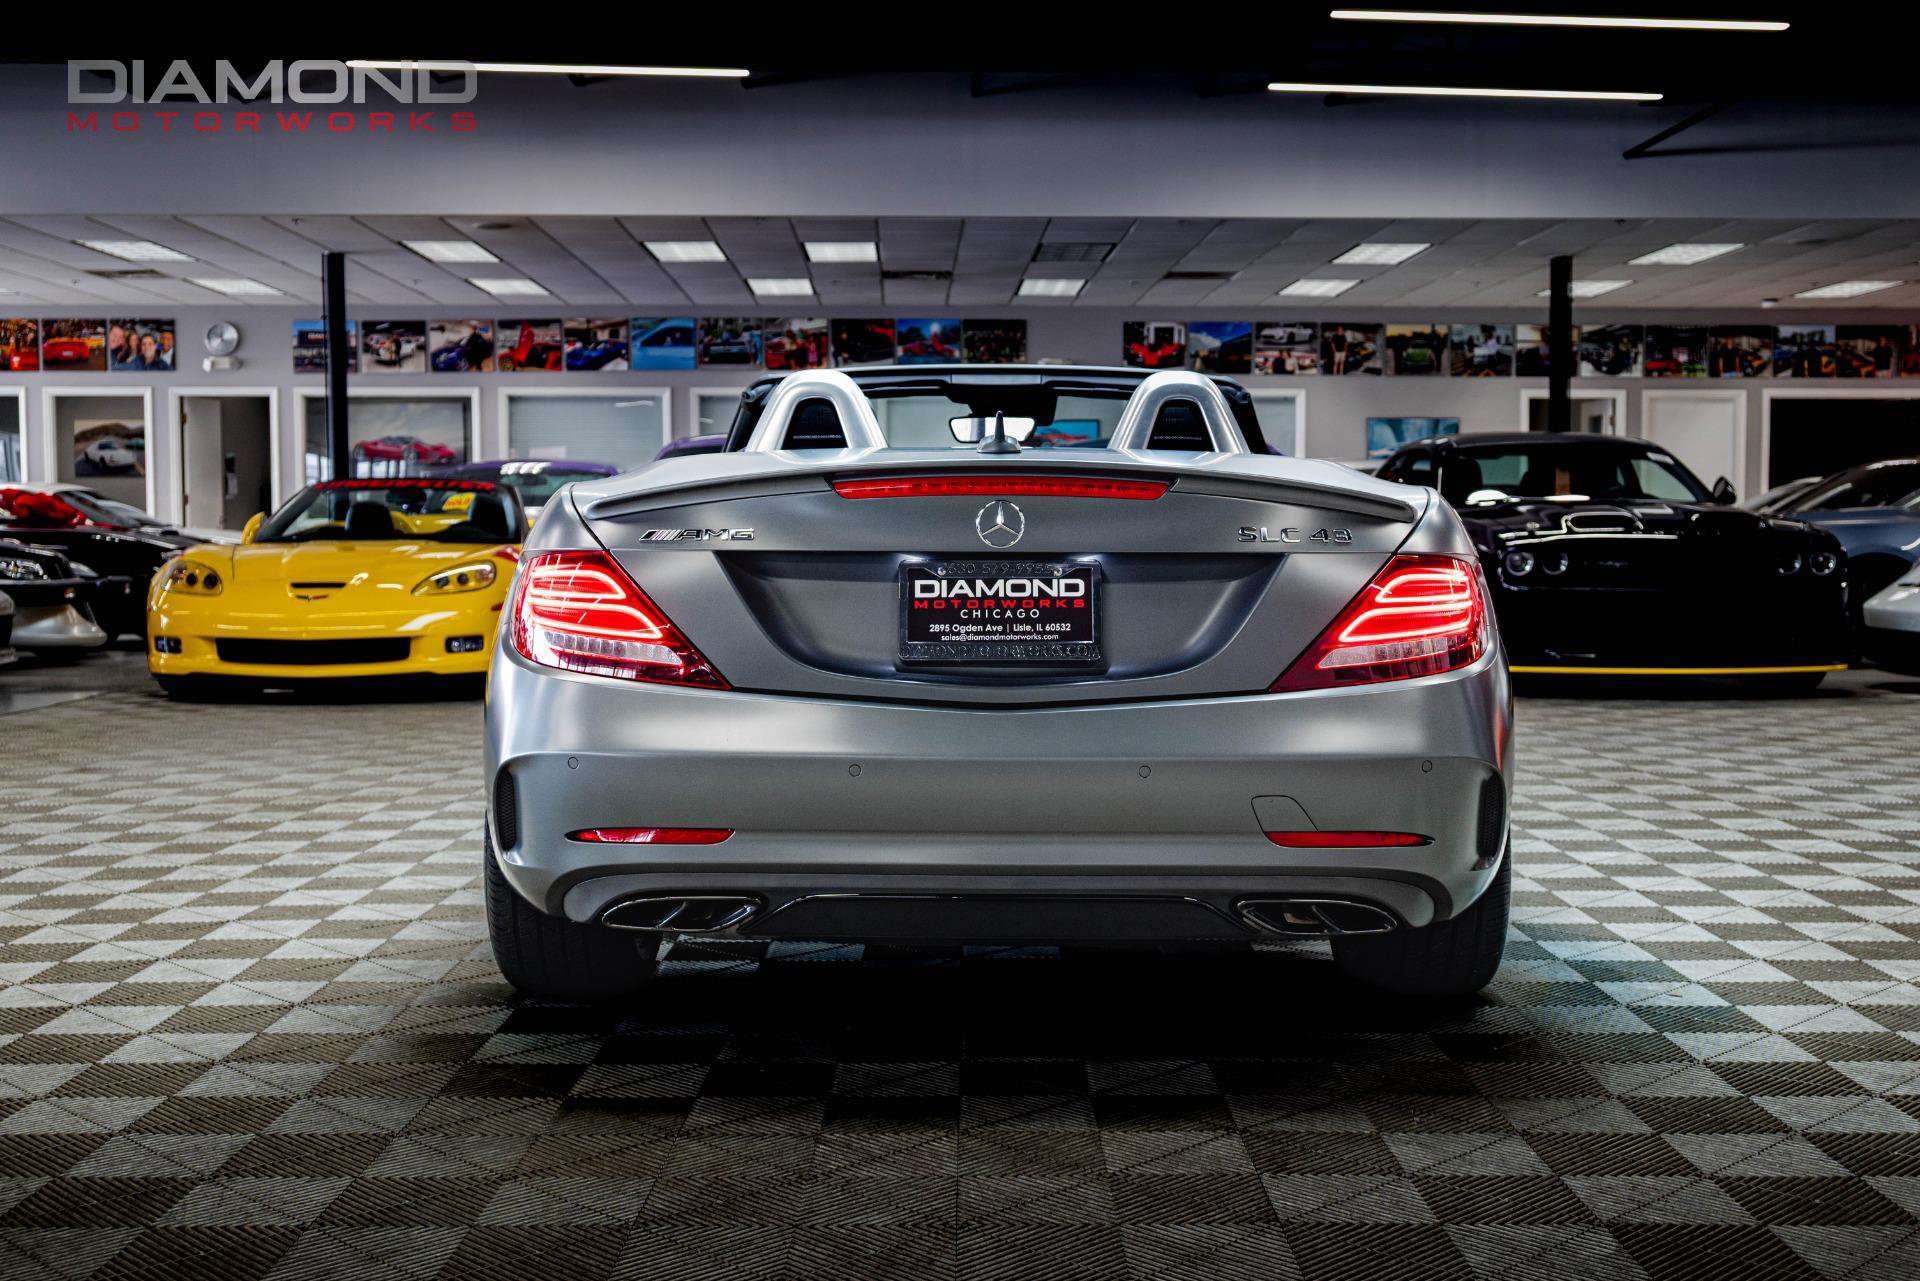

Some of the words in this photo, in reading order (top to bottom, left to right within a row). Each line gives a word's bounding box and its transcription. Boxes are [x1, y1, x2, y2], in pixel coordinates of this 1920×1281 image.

[681, 528, 755, 541] AMG
[1238, 526, 1301, 544] SLC
[1308, 528, 1354, 544] 43
[914, 578, 1085, 598] DIAMOND
[914, 599, 1085, 609] MOTORWORKS
[960, 609, 1040, 619] CHICAGO
[929, 624, 950, 632] 2895
[952, 624, 983, 634] Ogden
[985, 624, 1003, 632] Ave
[1013, 623, 1034, 632] Lisle,
[1036, 623, 1044, 631] IL
[1045, 623, 1071, 631] 60532
[941, 633, 1059, 642] sales@diamondmotorworks.com
